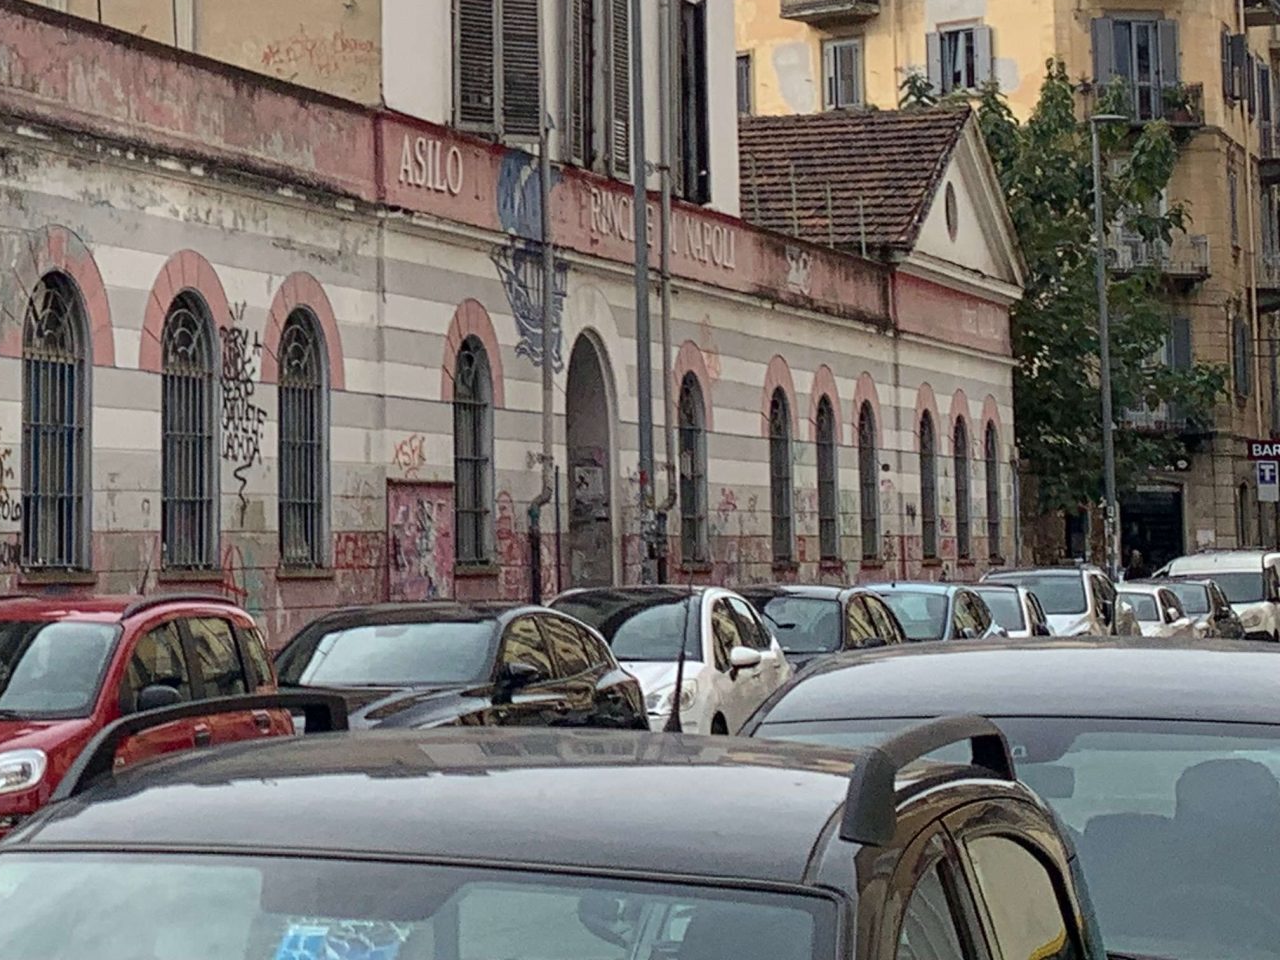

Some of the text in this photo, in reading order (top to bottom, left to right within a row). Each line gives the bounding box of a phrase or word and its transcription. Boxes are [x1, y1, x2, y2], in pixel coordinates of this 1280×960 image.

[398, 132, 464, 195] ASILO
[581, 186, 654, 248] RINCIE
[684, 215, 736, 270] NAPOLI
[1252, 444, 1280, 456] BAR
